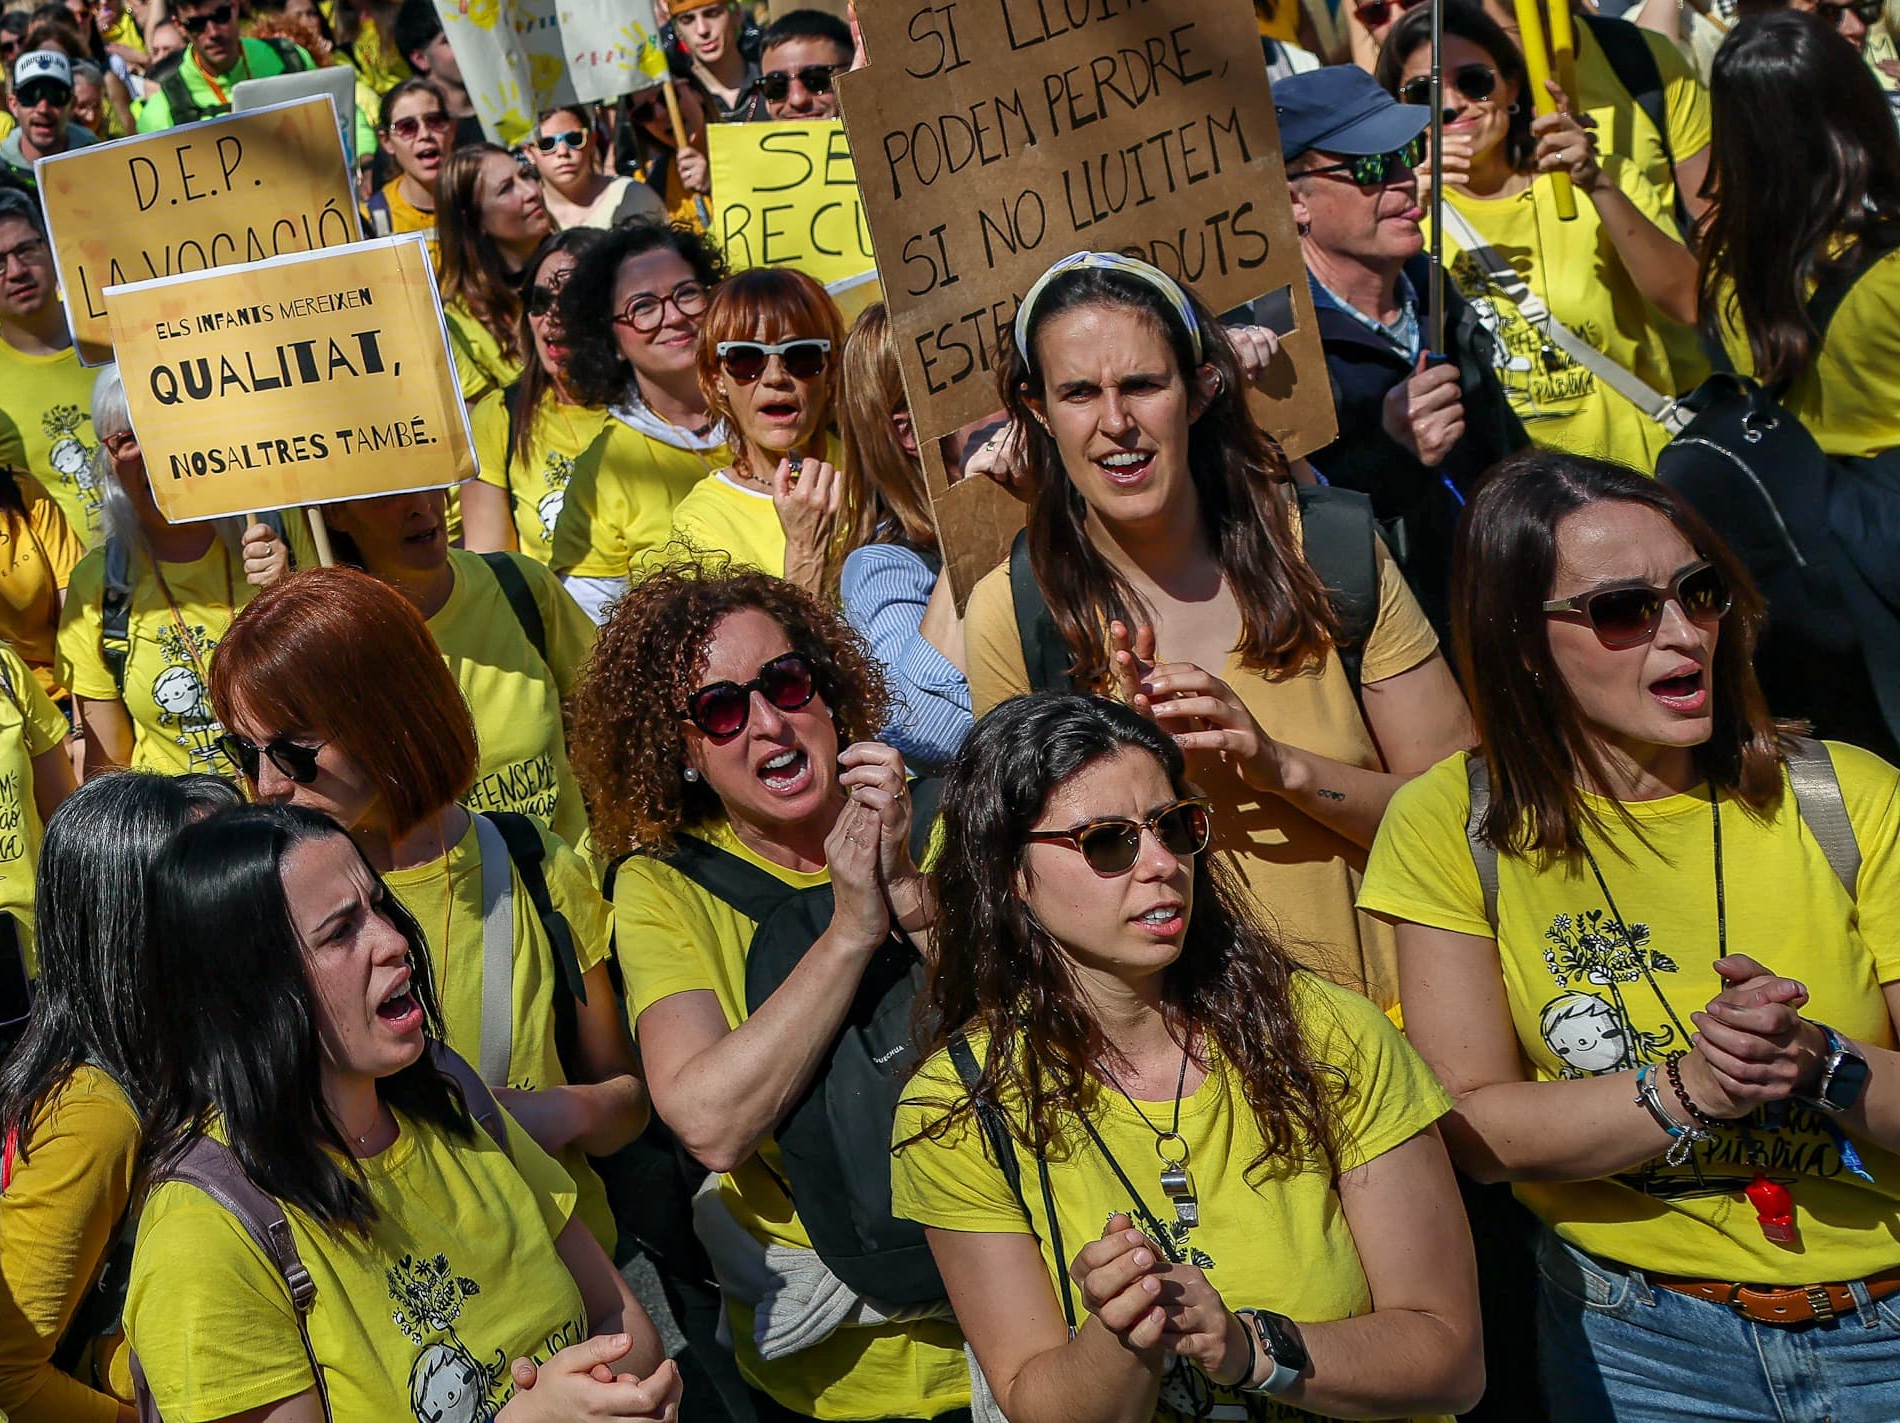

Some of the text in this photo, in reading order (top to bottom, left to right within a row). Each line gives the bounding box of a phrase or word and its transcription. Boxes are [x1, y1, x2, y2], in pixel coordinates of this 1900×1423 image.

[904, 2, 972, 80] SI
[129, 135, 261, 212] D.E.P.
[752, 129, 859, 193] SE
[882, 87, 1038, 200] PODEM
[723, 201, 876, 269] RECU
[902, 106, 1254, 296] SI NO LLUITEM
[155, 287, 373, 341] ELS INFANTS MEREIXEN
[915, 201, 1270, 395] ESTE DUTS
[149, 329, 402, 405] QUALITAT,
[168, 415, 438, 480] NOSALTRES TAMBÉ.
